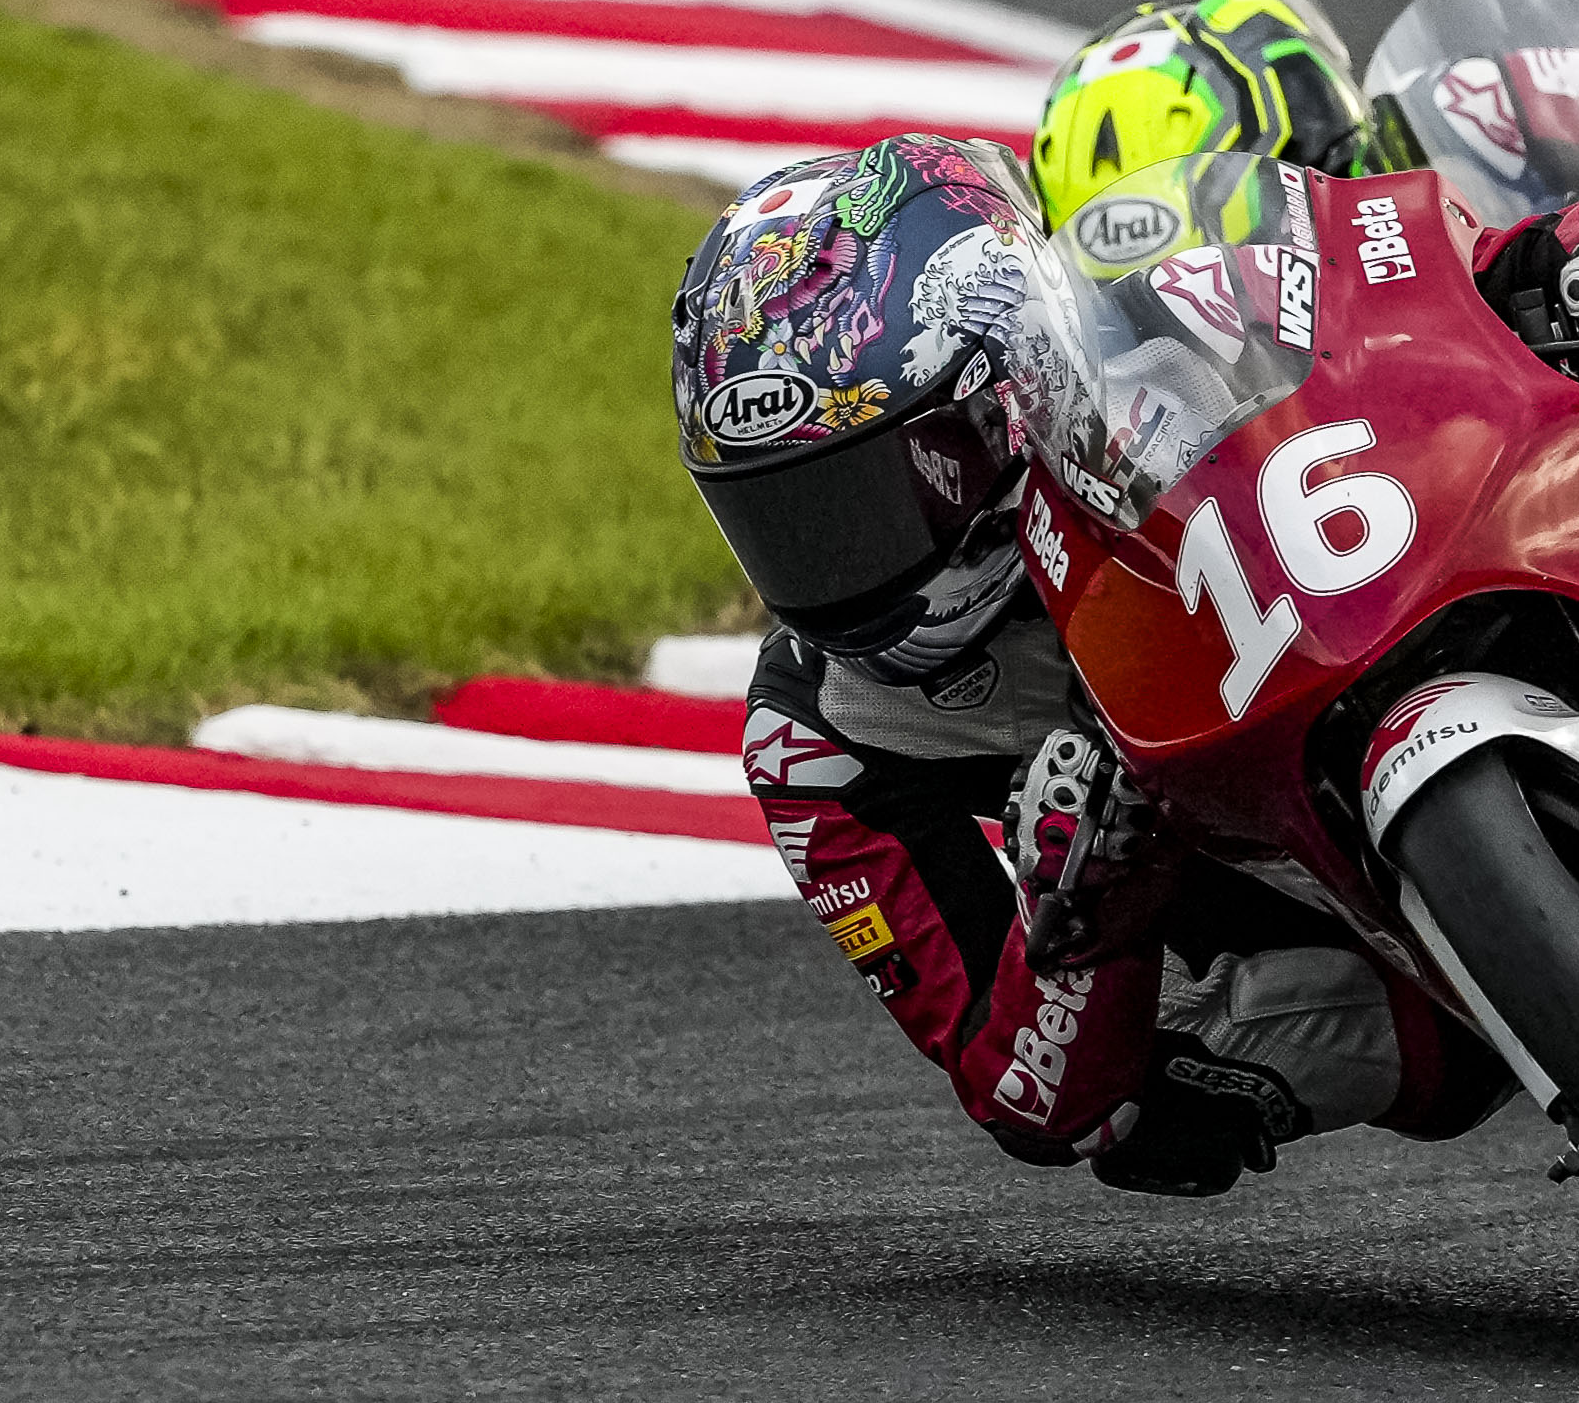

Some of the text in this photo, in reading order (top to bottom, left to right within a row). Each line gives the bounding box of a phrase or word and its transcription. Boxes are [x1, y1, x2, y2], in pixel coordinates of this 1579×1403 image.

[1090, 203, 1163, 247] Arai
[1351, 196, 1409, 262] Beta
[1279, 251, 1312, 350] WRS
[712, 378, 795, 432] Arai
[1062, 456, 1120, 515] WRS
[1033, 502, 1070, 592] Beta
[1176, 418, 1418, 722] 16
[940, 667, 993, 704] ROOKIES
[963, 685, 985, 703] CUP
[808, 877, 870, 915] mitsu
[829, 916, 880, 953] ELLI
